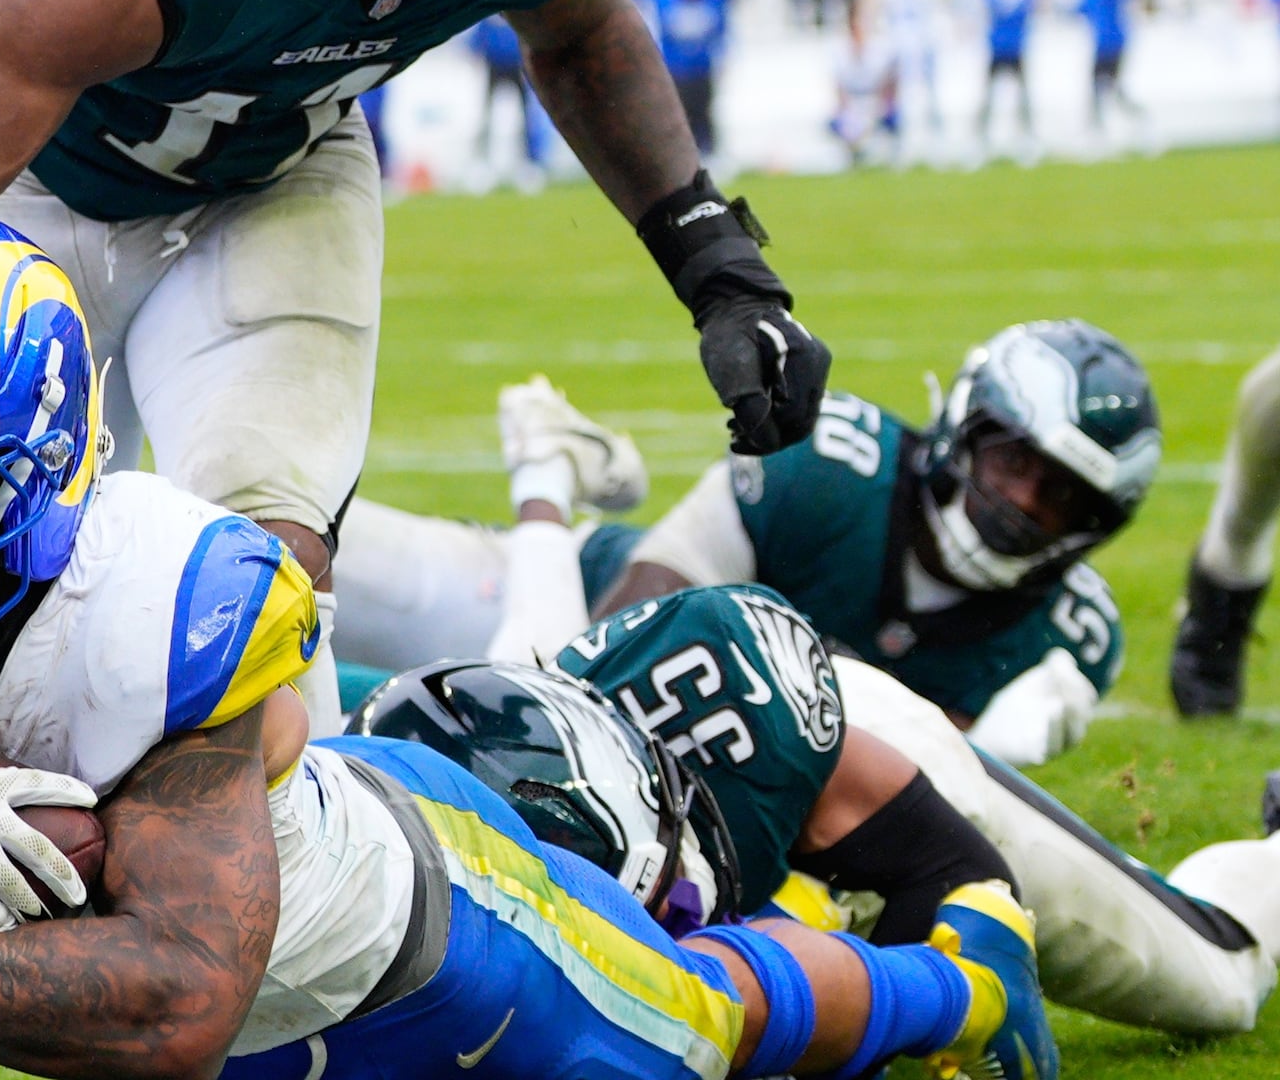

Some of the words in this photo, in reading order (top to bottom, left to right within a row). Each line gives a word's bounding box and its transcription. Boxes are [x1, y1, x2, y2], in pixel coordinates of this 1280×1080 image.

[271, 37, 399, 67] EAGLES
[102, 62, 395, 187] 11
[618, 642, 755, 766] 35
